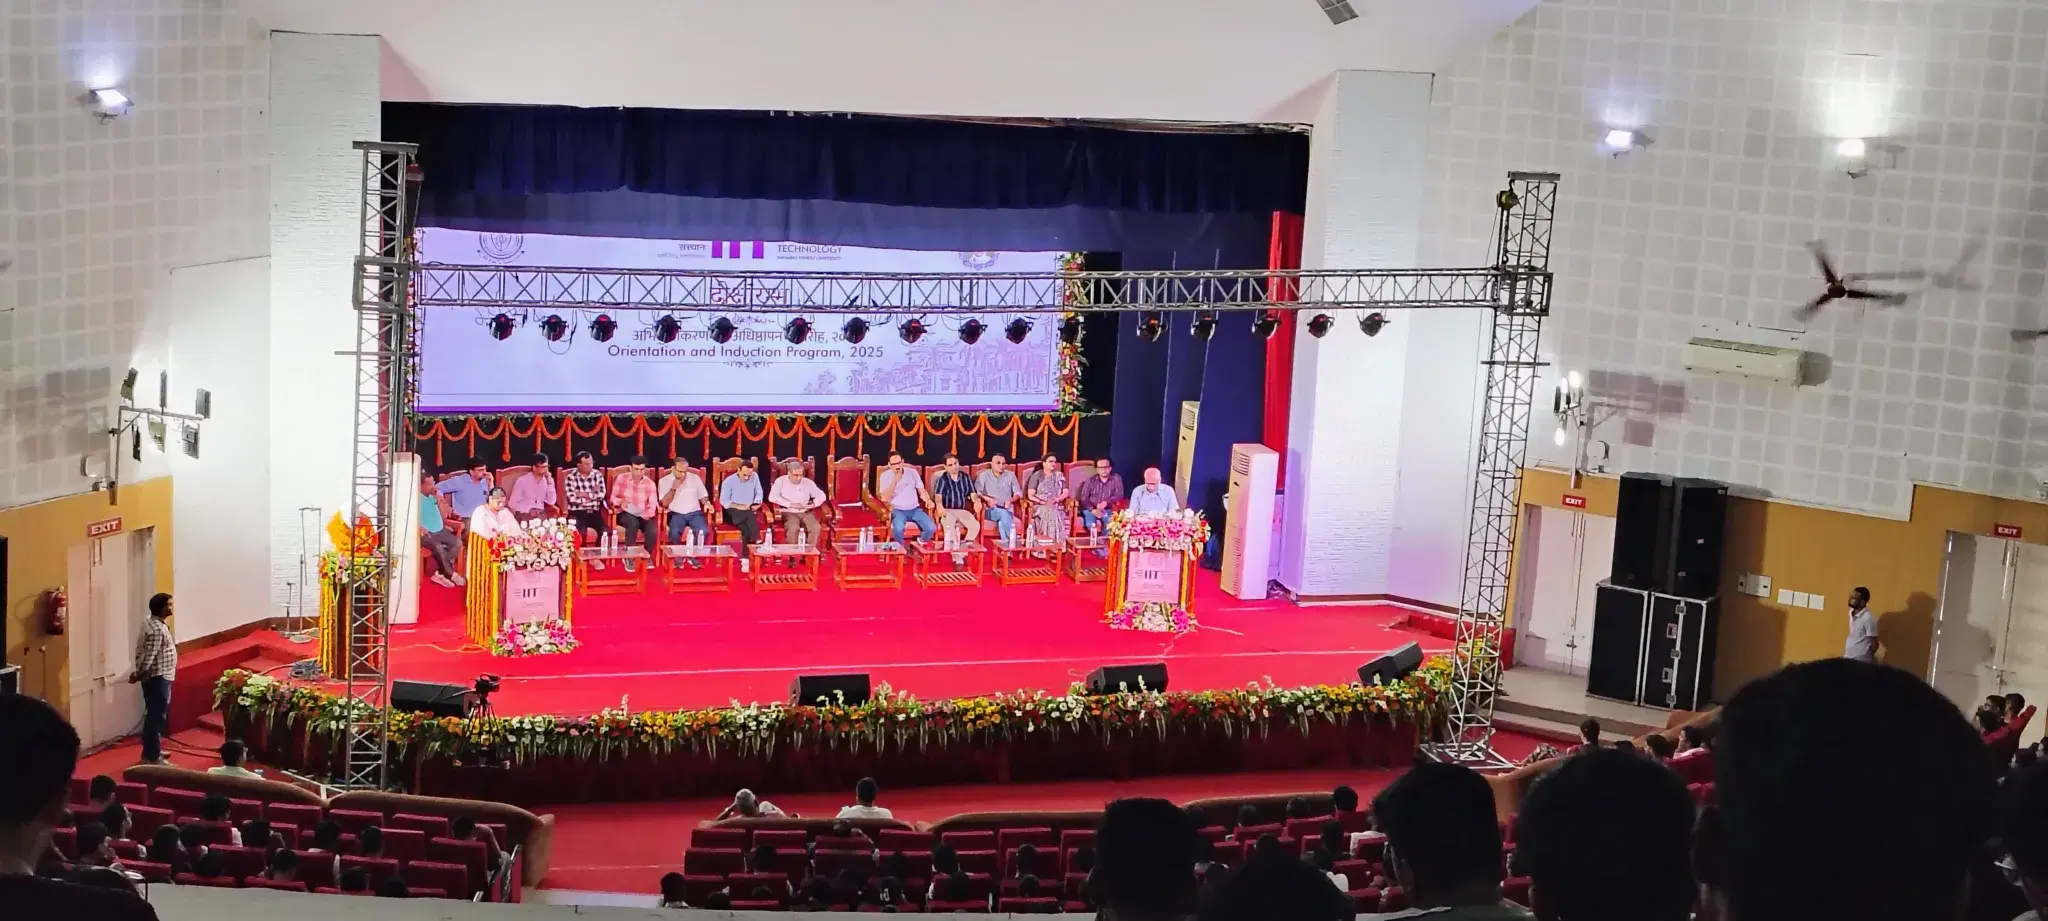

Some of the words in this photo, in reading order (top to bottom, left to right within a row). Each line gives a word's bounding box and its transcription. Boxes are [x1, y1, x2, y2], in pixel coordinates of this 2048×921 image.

[777, 244, 842, 254] TECHNOLOGY
[608, 345, 686, 357] Orientation
[690, 345, 716, 357] and
[721, 345, 781, 358] Induction
[786, 346, 845, 360] Program,
[850, 346, 884, 358] 2025
[91, 520, 119, 535] EXIT
[1144, 570, 1159, 580] IIT
[522, 588, 538, 598] IIT
